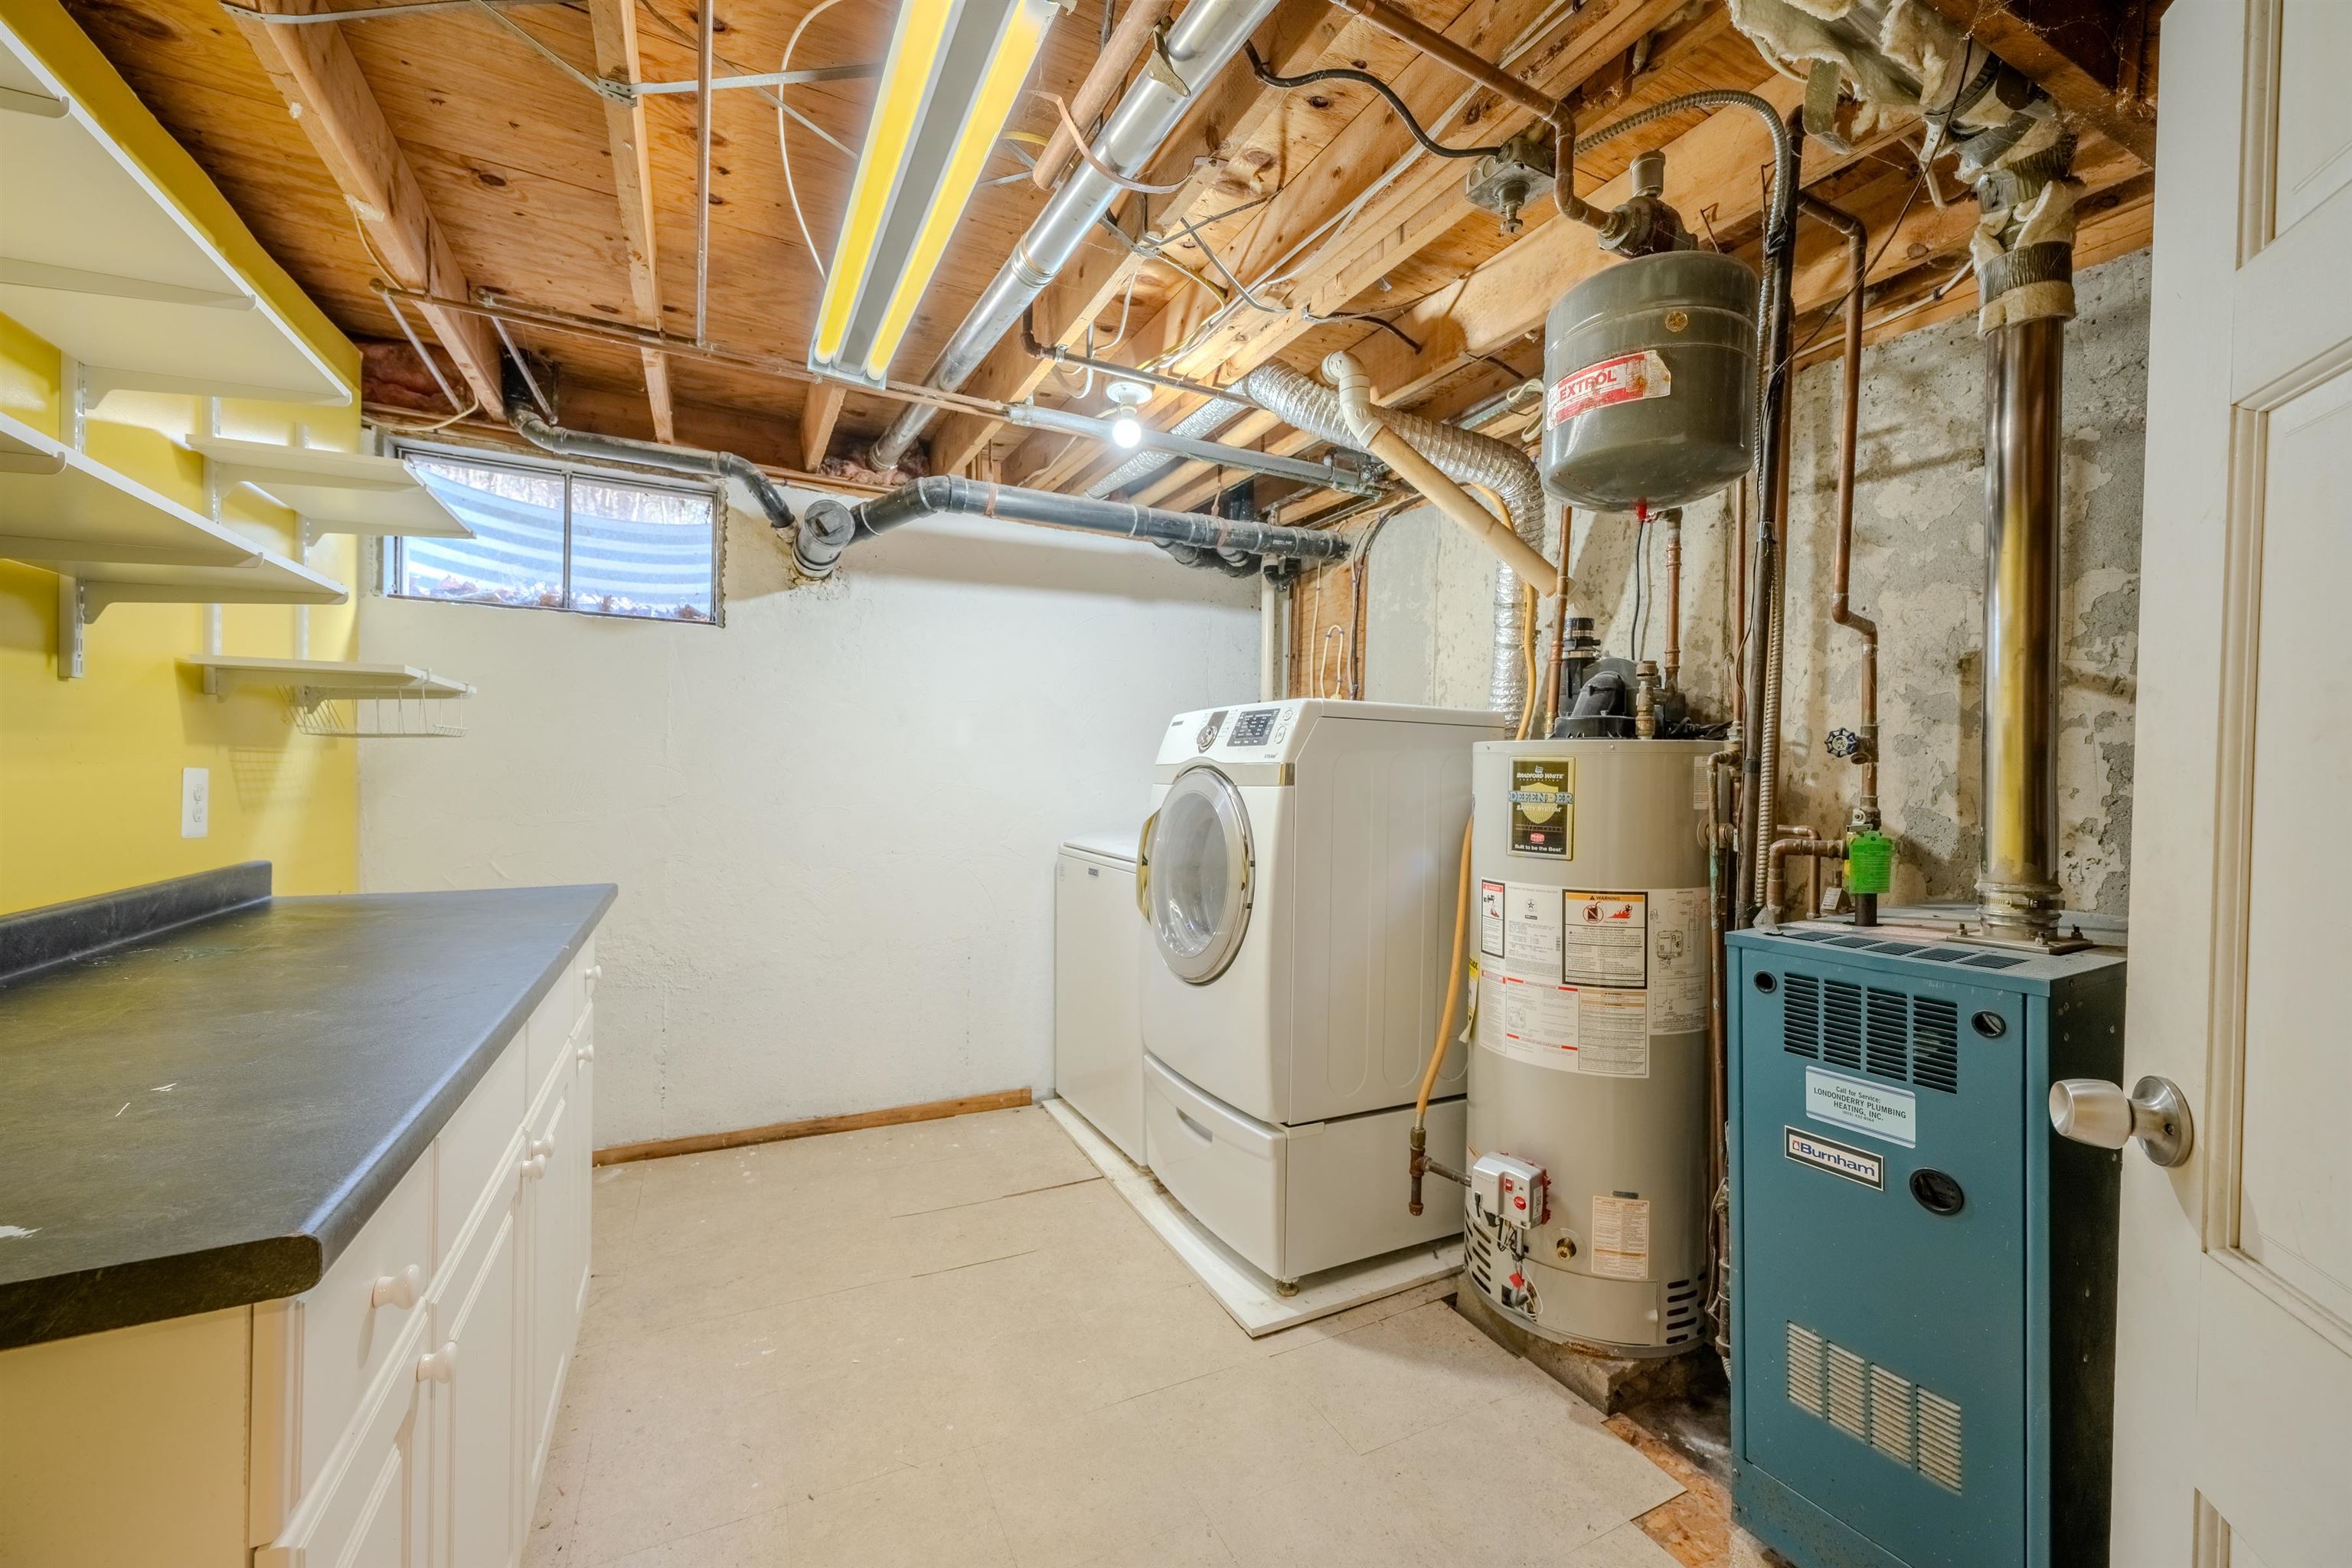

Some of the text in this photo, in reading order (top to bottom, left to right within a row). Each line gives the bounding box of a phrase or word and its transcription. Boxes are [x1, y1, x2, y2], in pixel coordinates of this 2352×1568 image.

[1560, 370, 1617, 401] EXTROL
[1508, 791, 1573, 804] DEFENDER
[1814, 1087, 1906, 1119] LONDONDERRY PLUMBING
[1858, 1093, 1881, 1103] Service:
[1869, 1110, 1884, 1121] INC.
[1801, 1142, 1875, 1177] Burnham
